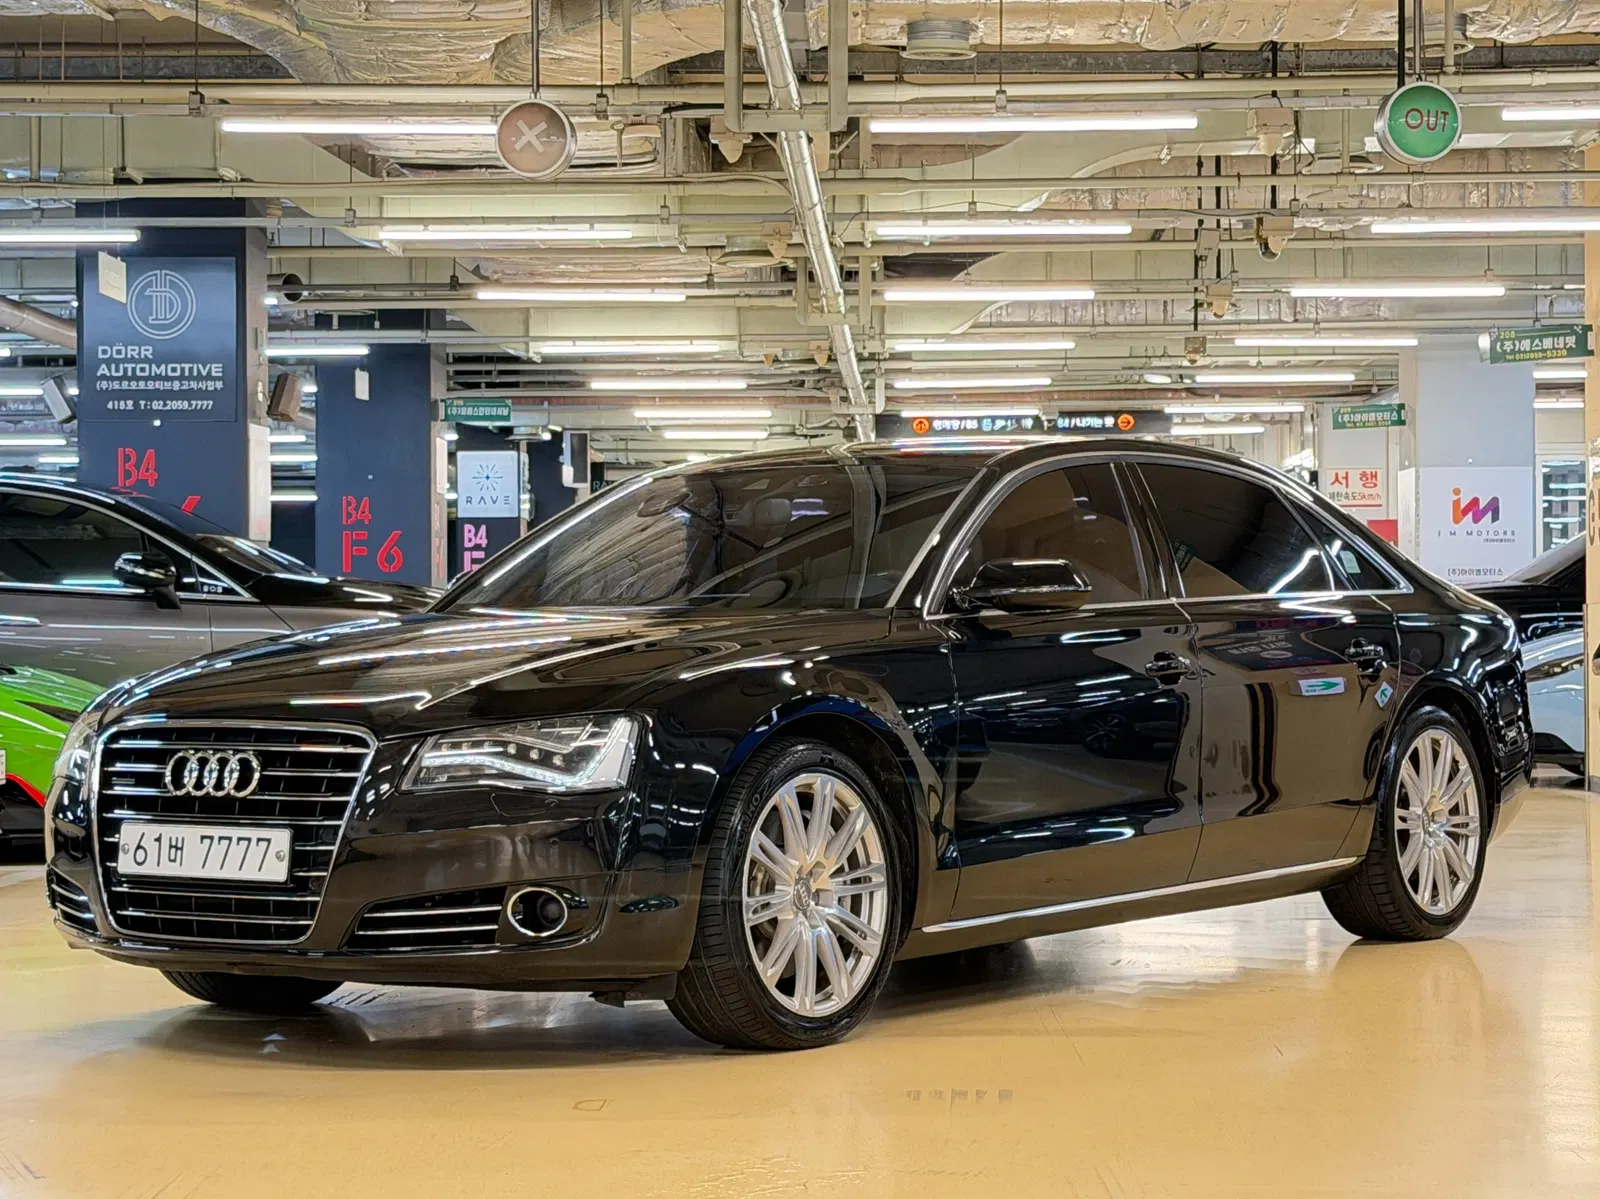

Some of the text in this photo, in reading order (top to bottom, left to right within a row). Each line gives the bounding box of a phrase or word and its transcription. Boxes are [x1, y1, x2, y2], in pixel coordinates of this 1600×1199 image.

[1405, 107, 1449, 133] OUT
[97, 343, 153, 359] DÖRR
[97, 363, 223, 377] AUTOMOTIVE
[117, 447, 158, 488] B4
[342, 495, 372, 525] B4
[465, 496, 511, 505] RAVE
[463, 523, 488, 548] B4
[133, 831, 272, 873] 61버 7777
